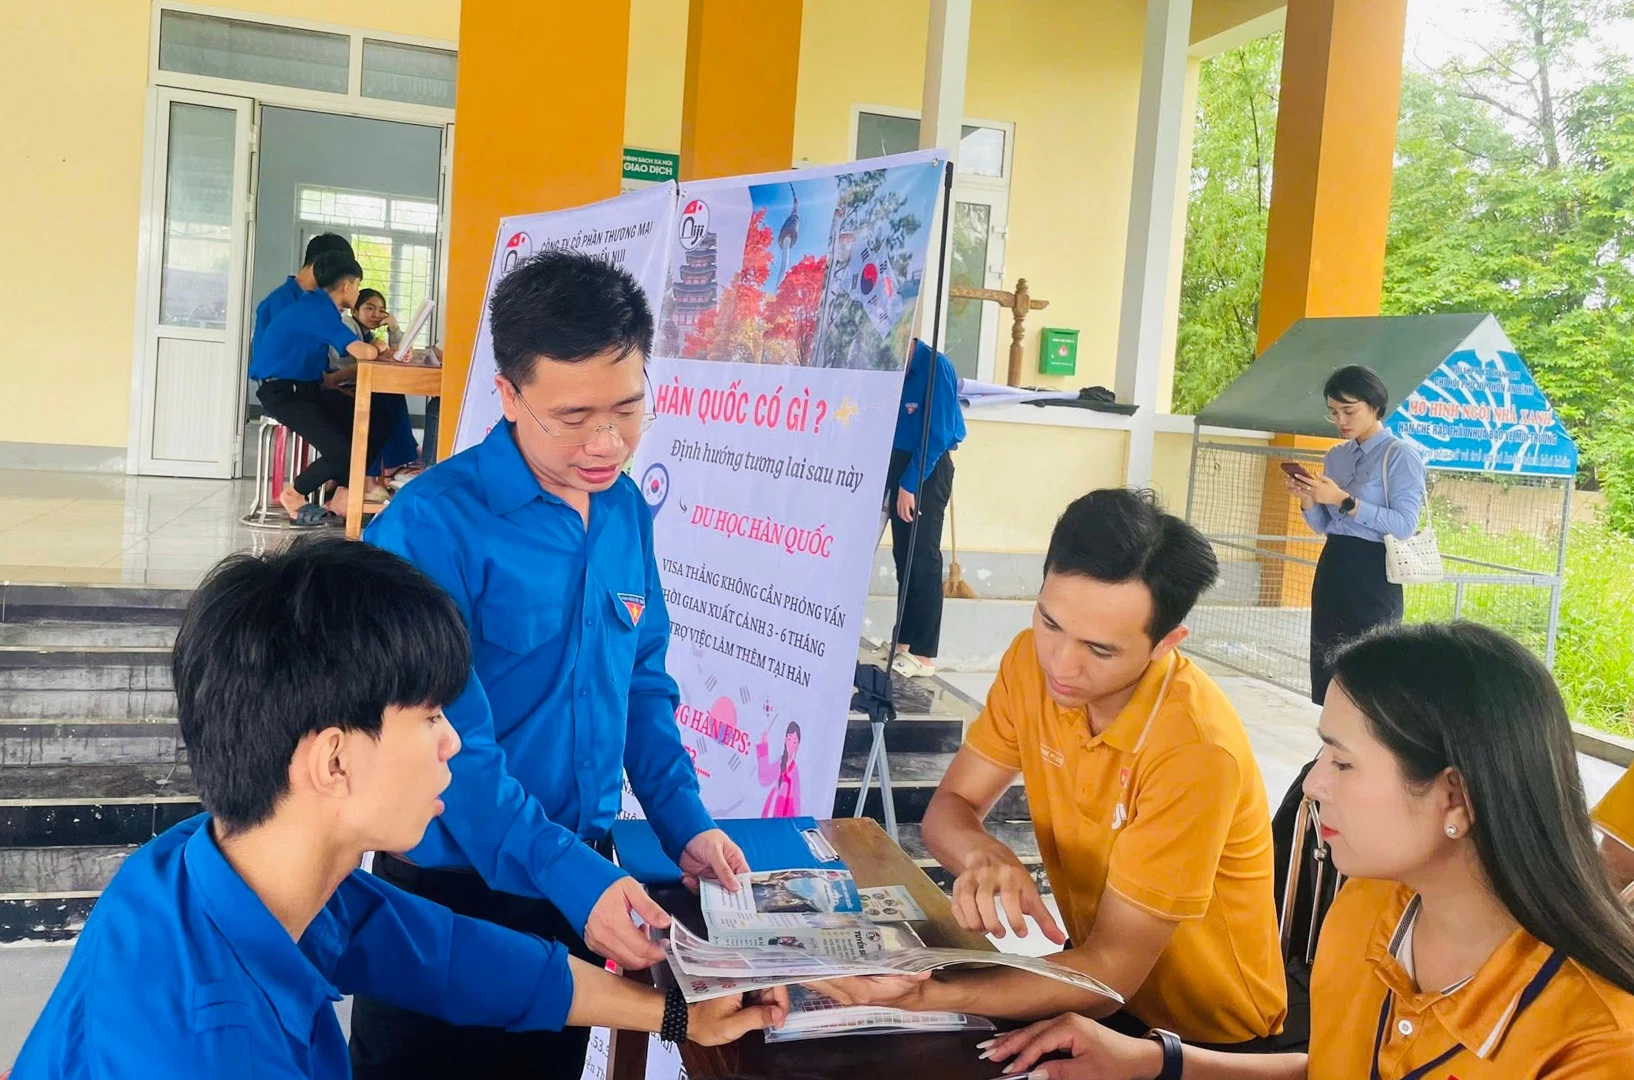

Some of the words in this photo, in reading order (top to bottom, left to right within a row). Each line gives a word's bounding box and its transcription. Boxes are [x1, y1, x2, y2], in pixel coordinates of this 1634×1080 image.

[624, 162, 648, 172] GIAO
[649, 165, 673, 176] DỊCH
[561, 238, 571, 251] TY
[570, 230, 582, 249] CỔ
[582, 228, 603, 248] PHẦN
[604, 224, 637, 244] THƯƠNG
[638, 221, 654, 243] MẠI
[656, 376, 694, 416] HÀN
[697, 379, 750, 425] QUỐC
[753, 385, 784, 428] CÓ
[786, 386, 810, 432] GÌ
[813, 400, 827, 434] ?
[1410, 398, 1428, 415] MÔ
[1462, 404, 1490, 421] NGÔI
[1494, 406, 1517, 422] NHÀ
[1520, 410, 1553, 425] XANH
[670, 438, 702, 462] Định
[702, 442, 744, 472] hướng
[744, 452, 784, 480] tương
[785, 455, 807, 479] lai
[806, 462, 833, 484] sau
[835, 464, 864, 493] này
[690, 504, 716, 528] DU
[714, 510, 749, 538] HỌC
[748, 516, 786, 545] HÀN
[784, 524, 834, 558] QUỐC
[662, 558, 684, 577] VISA
[686, 563, 720, 587] THẲNG
[720, 576, 759, 600] KHÔNG
[759, 584, 786, 607] CẦN
[785, 595, 822, 620] PHỎNG
[824, 604, 846, 628] VẤN
[662, 588, 682, 602] HỜI
[682, 594, 706, 614] GIAN
[707, 602, 736, 624] XUẤT
[736, 612, 766, 635] CẢNH
[766, 623, 774, 638] 3
[780, 628, 787, 642] 6
[788, 630, 826, 658] THÁNG
[669, 620, 690, 641] TRỢ
[690, 628, 712, 648] VIỆC
[713, 636, 734, 656] LÀM
[736, 645, 766, 669] THÊM
[768, 656, 786, 678] TẠI
[786, 666, 812, 688] HÀN
[690, 709, 722, 740] HÀN
[721, 723, 751, 756] EPS:
